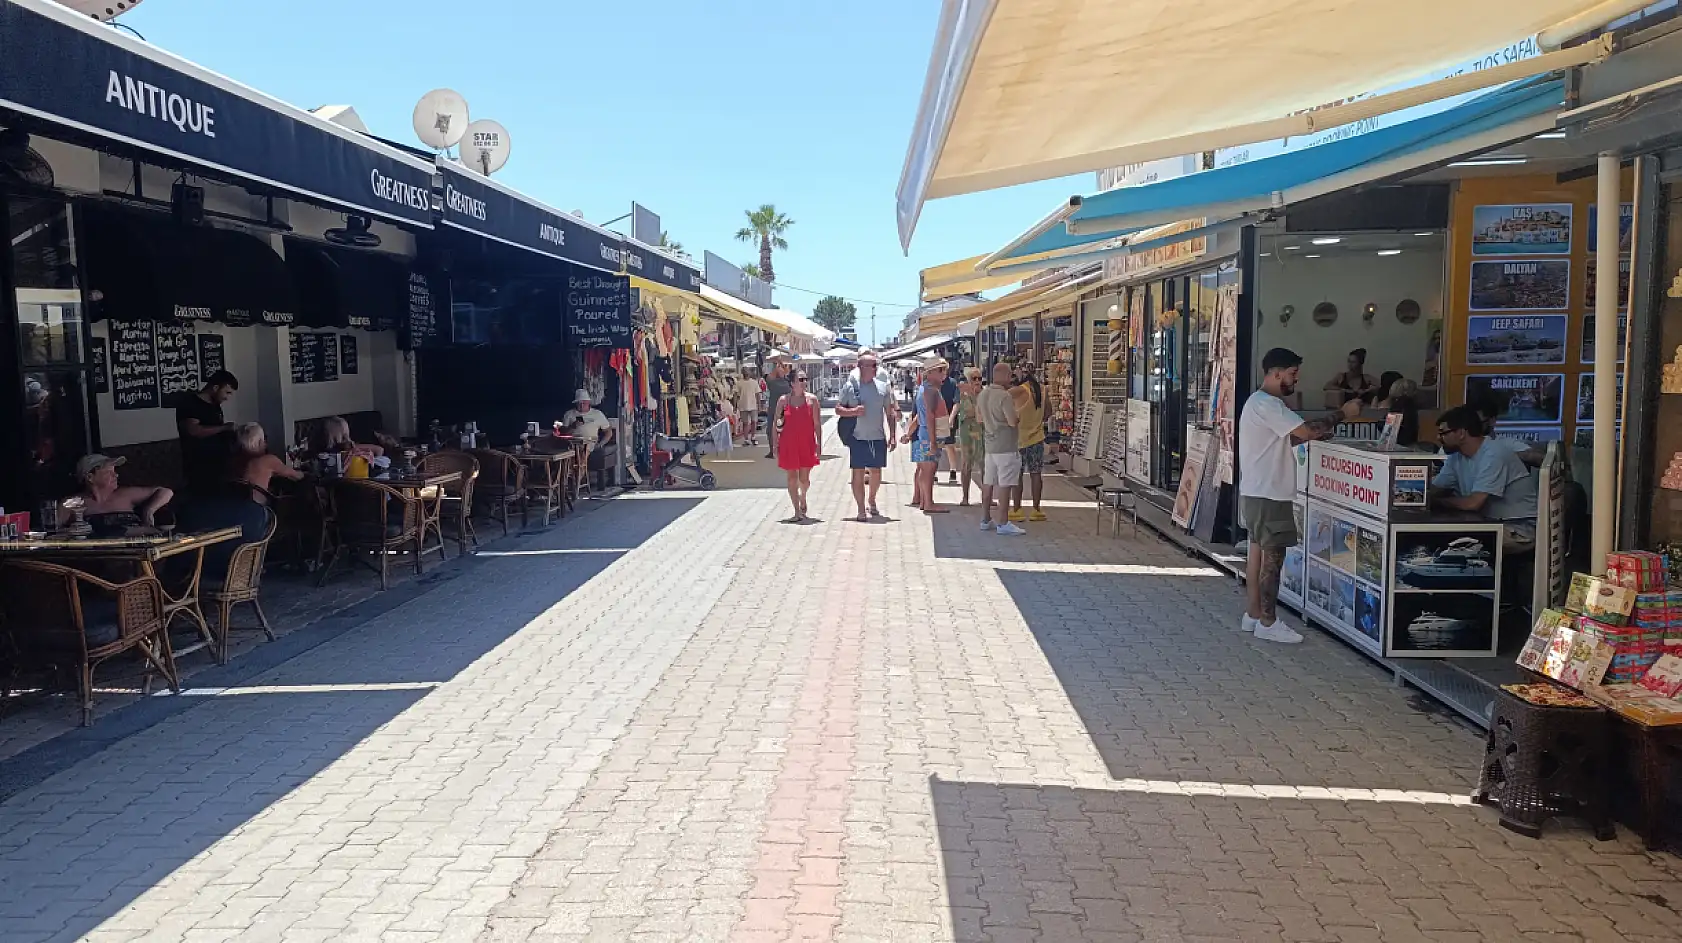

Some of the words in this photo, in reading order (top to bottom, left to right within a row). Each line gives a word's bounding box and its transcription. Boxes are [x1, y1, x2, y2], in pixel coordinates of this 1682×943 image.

[106, 69, 216, 139] ANTIQUE
[473, 132, 499, 141] STAR
[371, 168, 429, 212] GREATNESS
[446, 182, 486, 221] GREATNESS
[539, 222, 565, 247] ANTIQUE
[1503, 263, 1537, 275] DALYAN
[568, 276, 592, 289] Best
[567, 291, 627, 306] Guinness
[574, 308, 620, 320] Poured
[569, 325, 587, 335] The
[1491, 318, 1511, 330] JEEP
[1512, 317, 1544, 329] SAFARI
[1490, 377, 1539, 389] SAKLIKENT
[119, 389, 152, 405] Mojitos
[1321, 454, 1373, 481] EXCURSIONS
[1314, 474, 1350, 497] BOOKING
[1353, 484, 1381, 507] POINT
